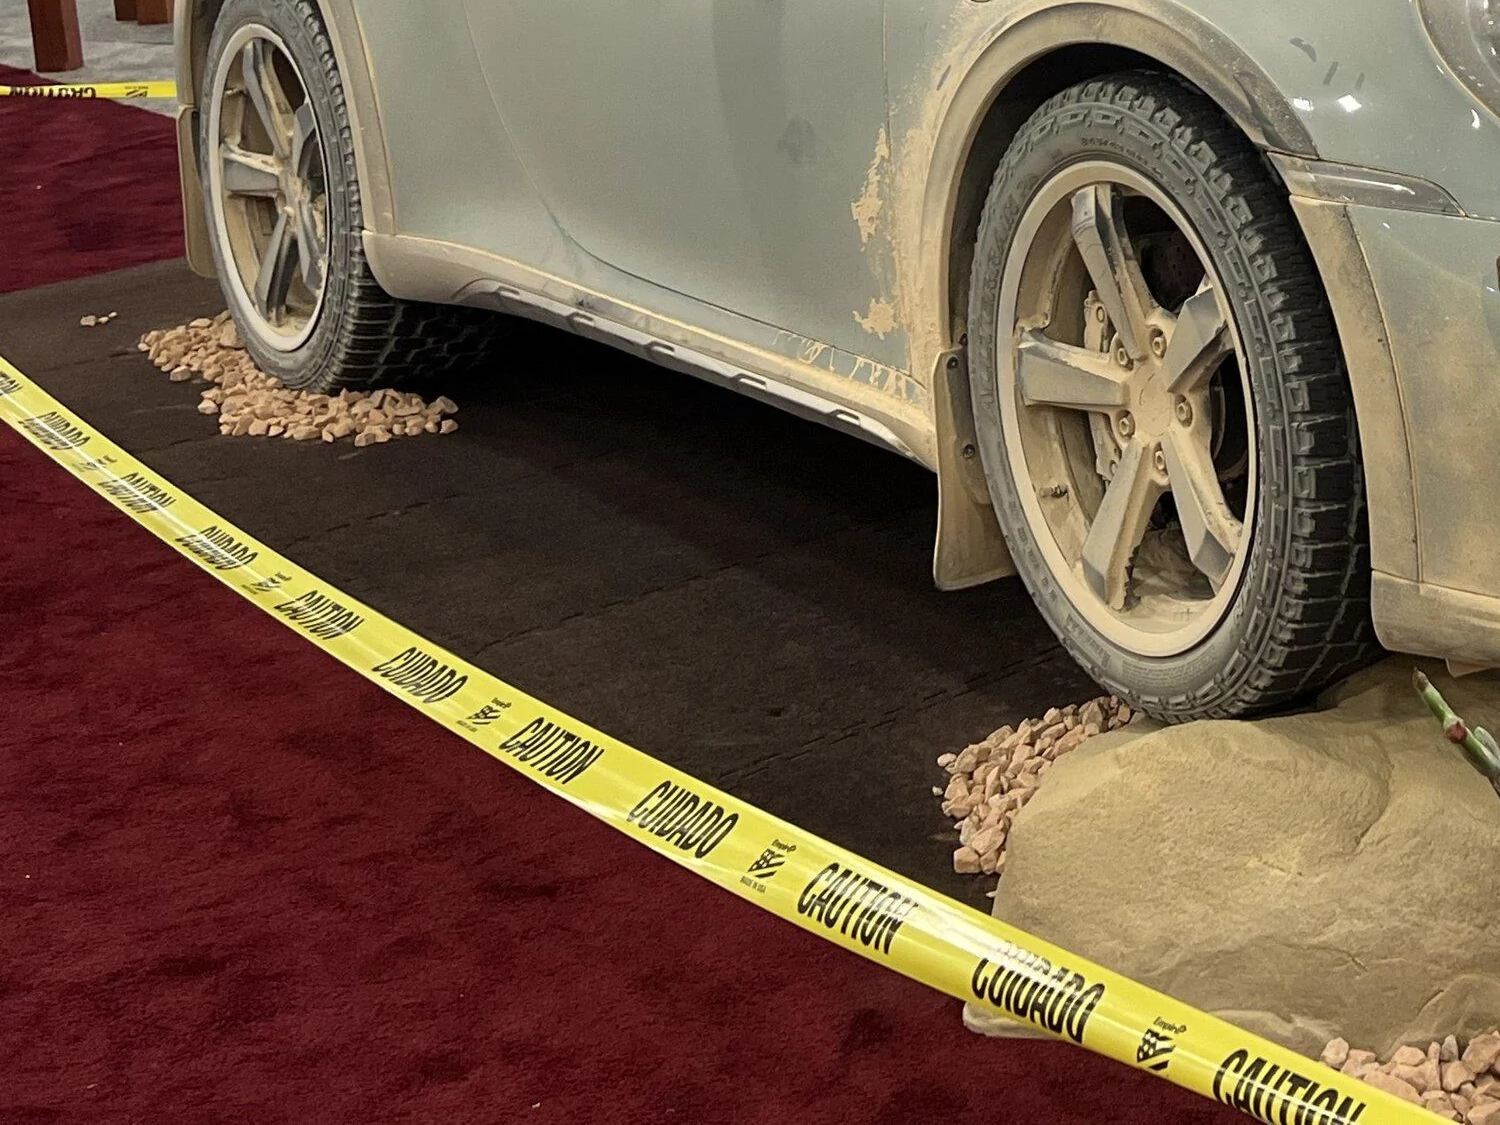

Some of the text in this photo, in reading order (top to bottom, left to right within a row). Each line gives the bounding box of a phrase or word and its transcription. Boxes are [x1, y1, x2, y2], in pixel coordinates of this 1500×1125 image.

[273, 590, 365, 641] CAUTION
[371, 646, 469, 704] CUIDADO
[499, 716, 605, 785] CAUTION
[625, 780, 739, 859] CUIDADO
[797, 861, 920, 955] CAUTION
[971, 938, 1106, 1044] CUIDADO
[1212, 1048, 1367, 1125] CAUTION
